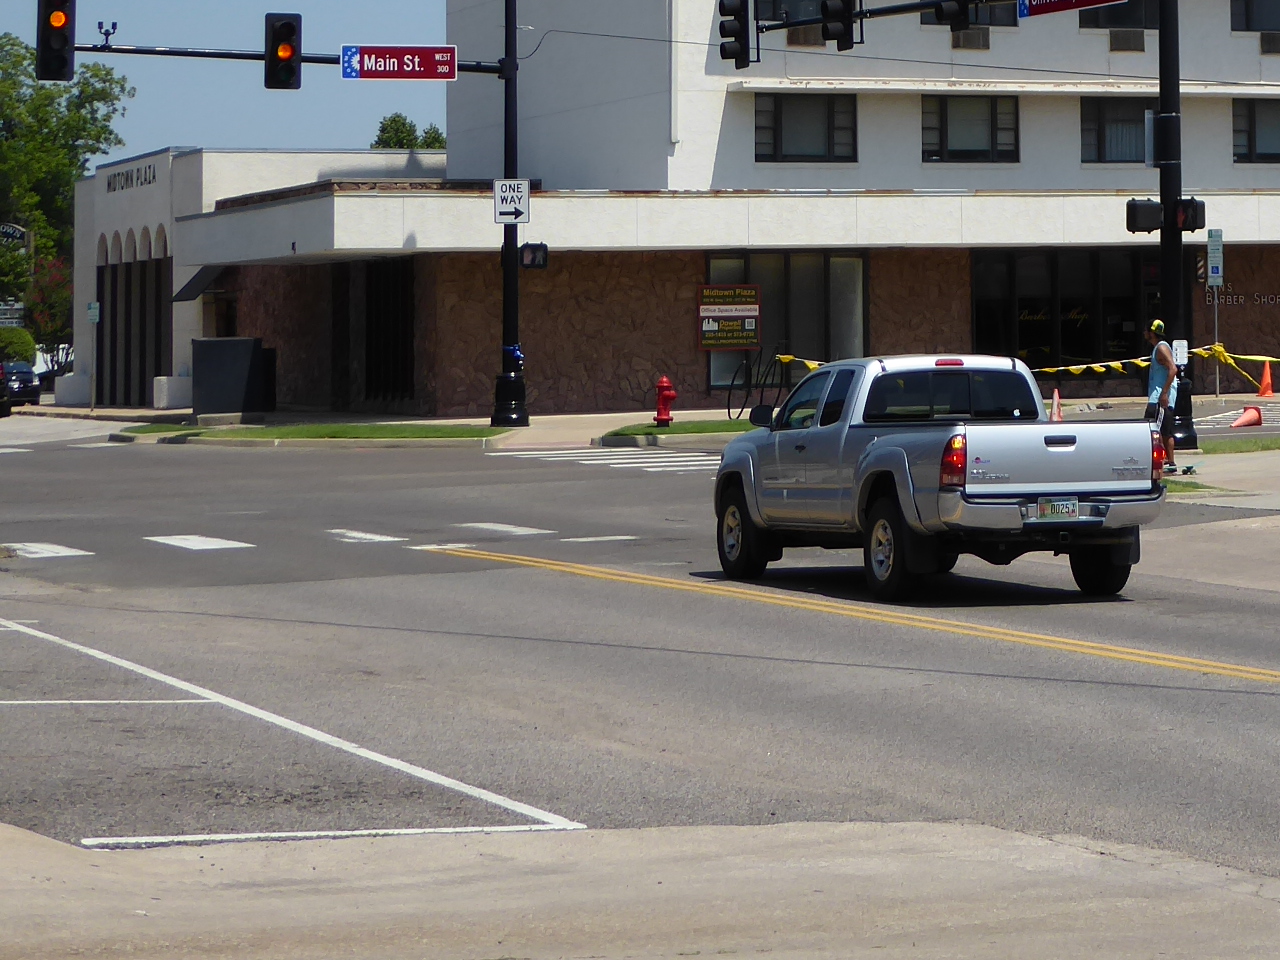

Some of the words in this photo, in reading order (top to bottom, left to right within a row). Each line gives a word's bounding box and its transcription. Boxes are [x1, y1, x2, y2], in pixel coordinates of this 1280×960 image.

[435, 53, 451, 61] WEST
[364, 54, 398, 71] Main
[403, 54, 424, 71] St.
[436, 65, 449, 73] 300
[106, 169, 134, 193] MIDTOWN
[136, 164, 156, 187] PLAZA
[500, 183, 523, 193] ONE
[500, 195, 524, 205] WAY
[703, 288, 734, 296] Midtown
[1205, 282, 1233, 293] KNS
[1051, 503, 1070, 514] 0025
